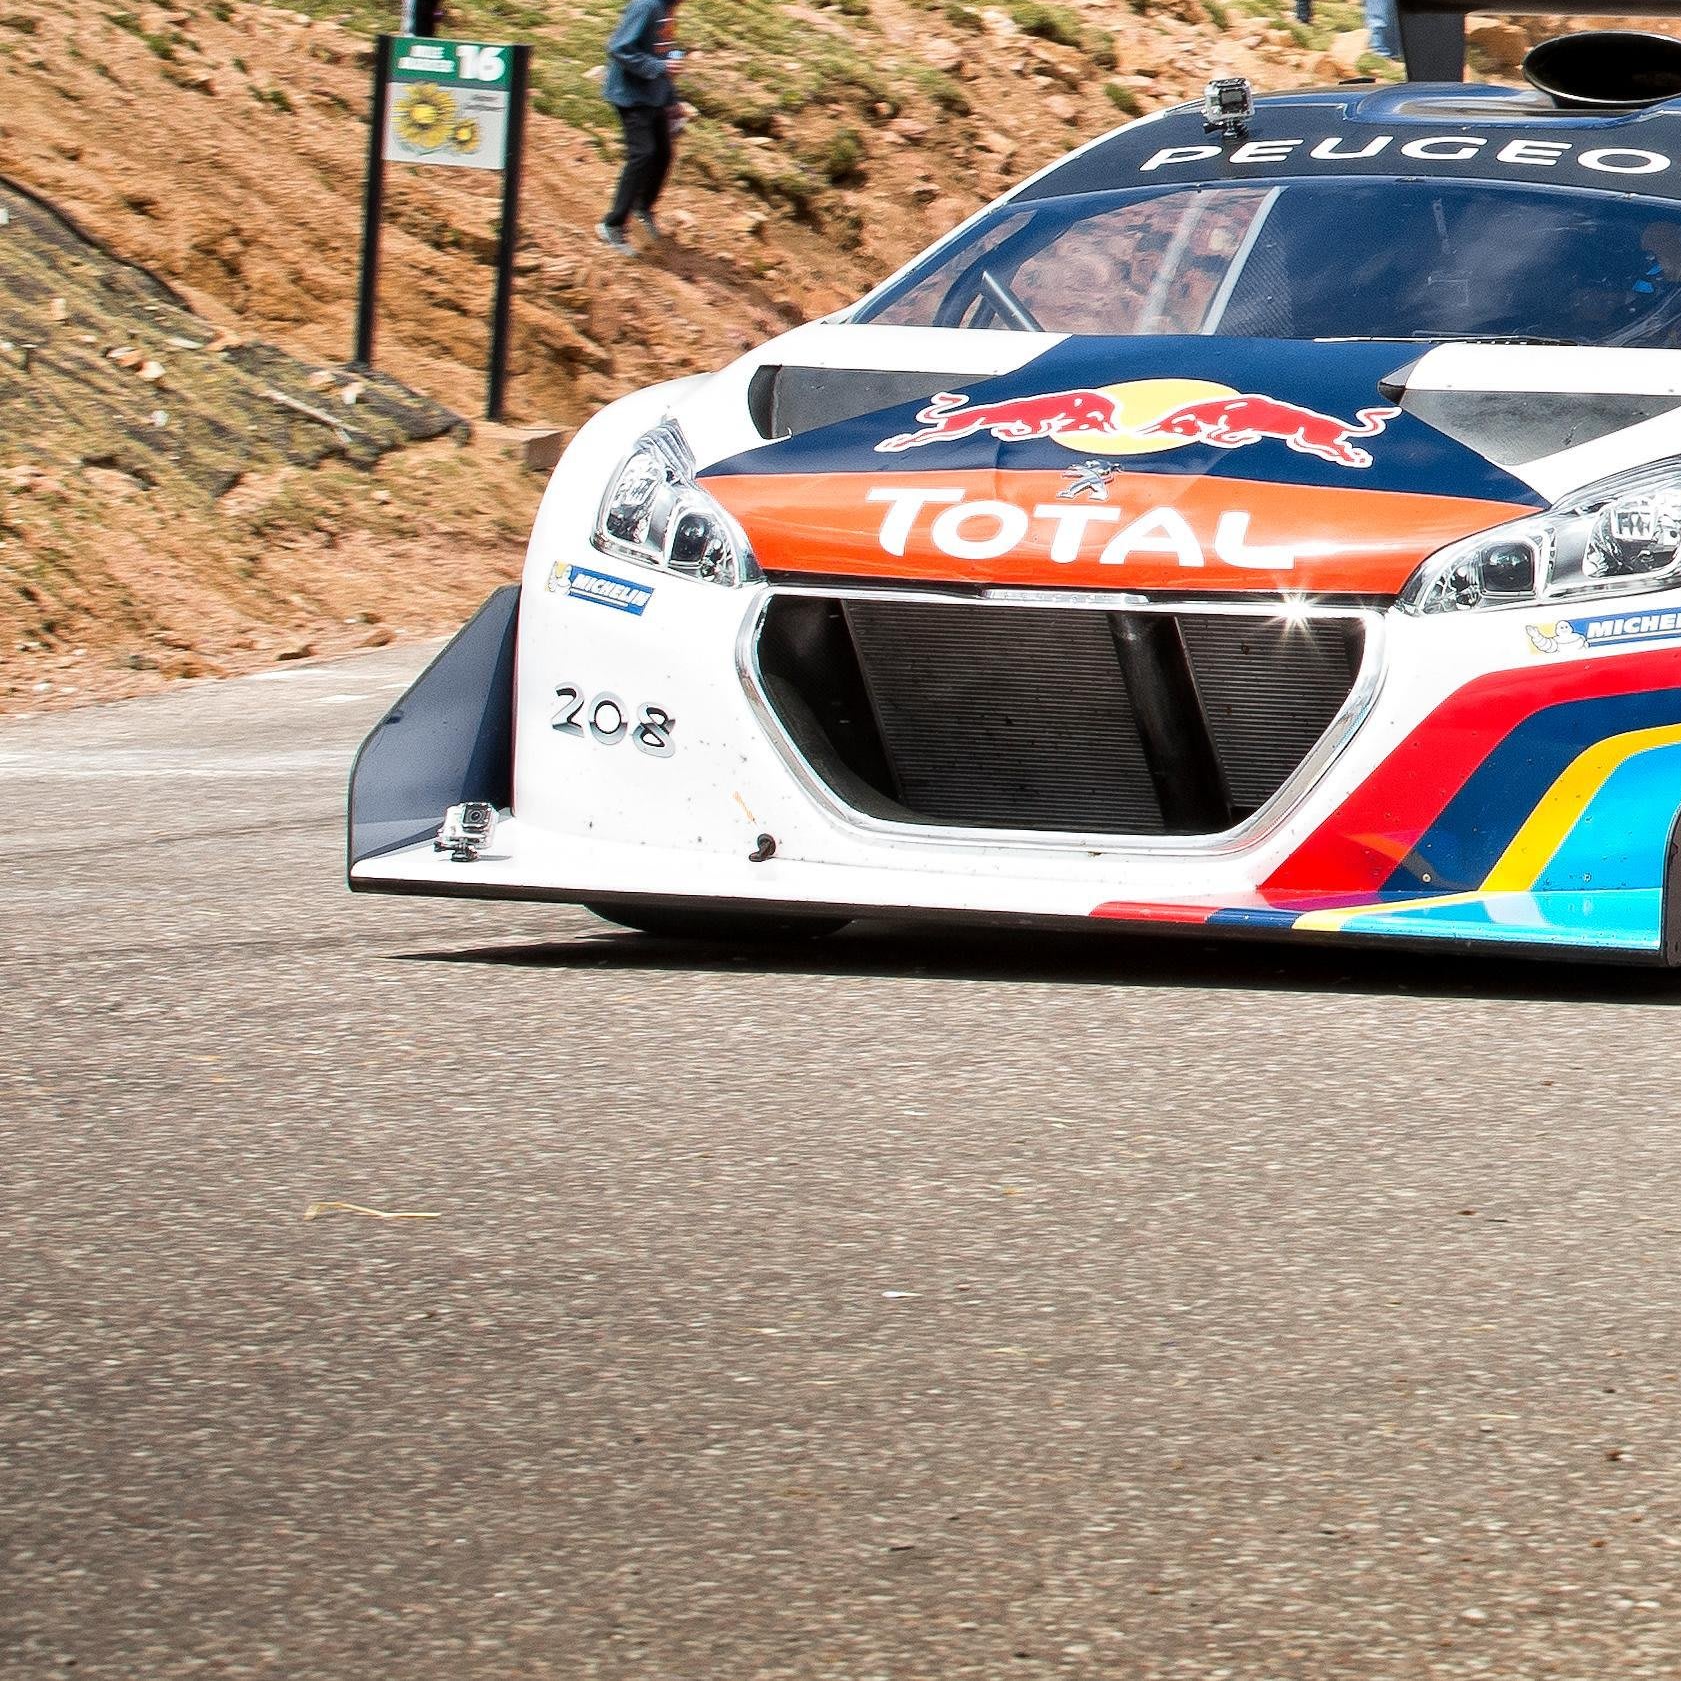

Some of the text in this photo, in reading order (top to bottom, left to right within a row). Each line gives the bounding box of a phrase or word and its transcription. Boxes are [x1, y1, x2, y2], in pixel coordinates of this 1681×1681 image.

[456, 45, 505, 81] 16
[866, 487, 1297, 570] TOTAL
[570, 573, 651, 607] MICHELIN
[551, 681, 676, 758] 208
